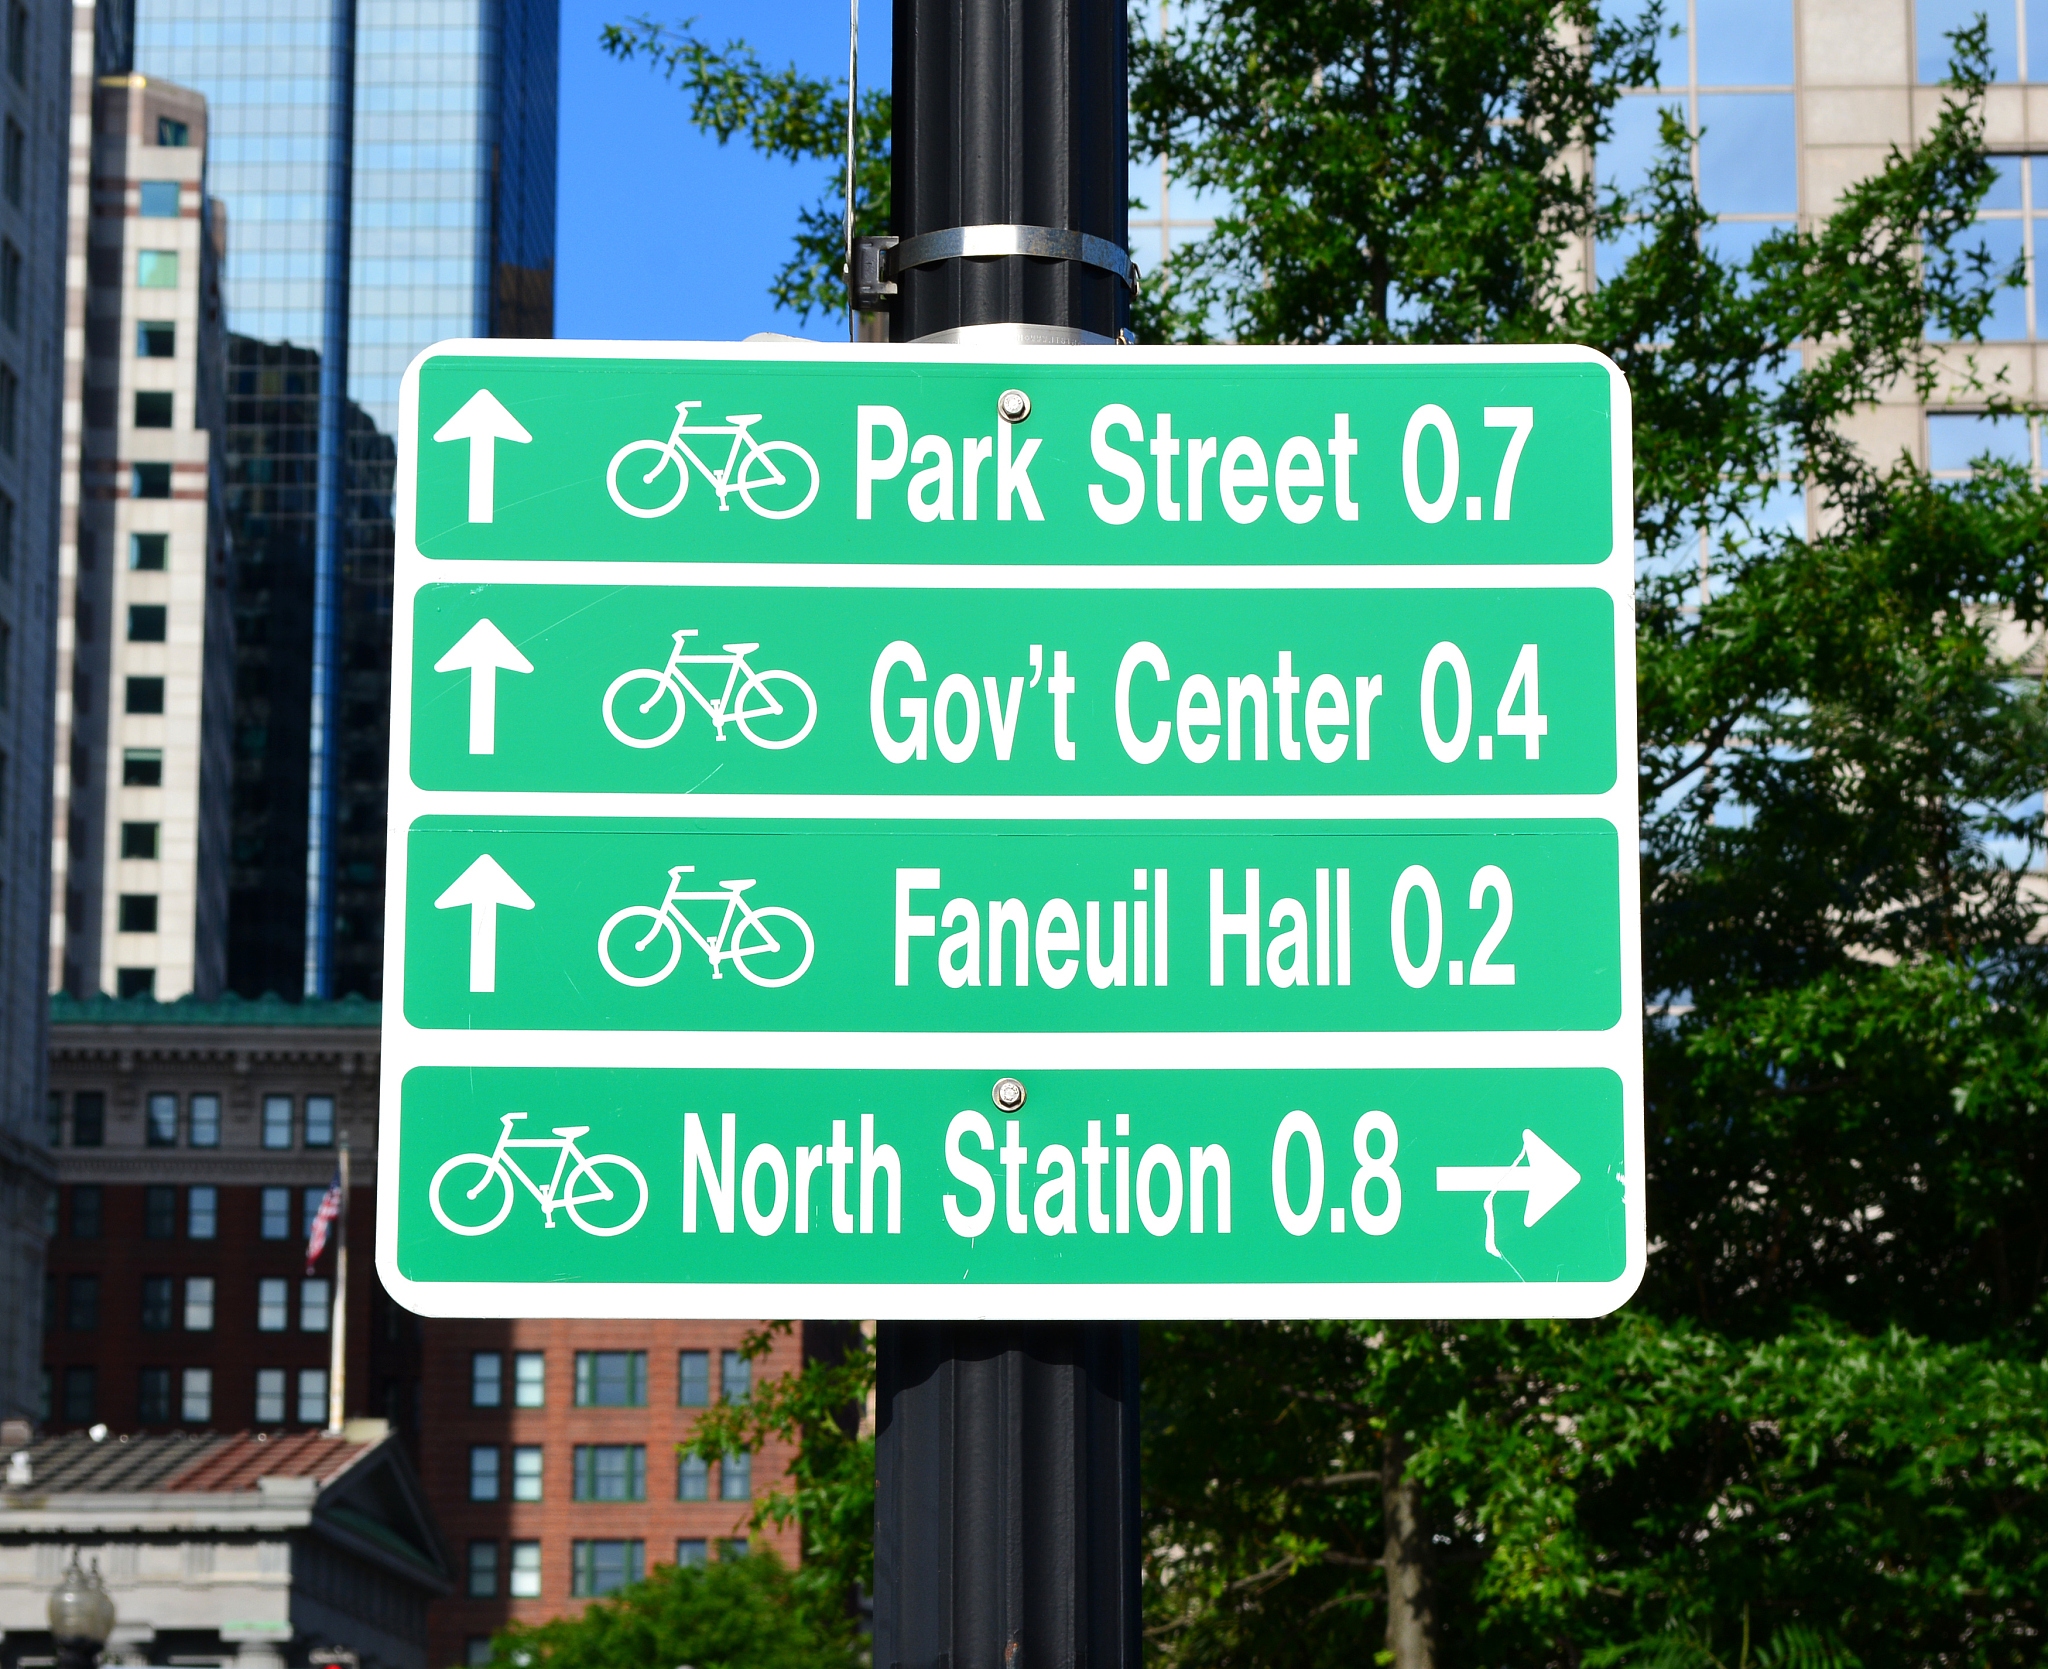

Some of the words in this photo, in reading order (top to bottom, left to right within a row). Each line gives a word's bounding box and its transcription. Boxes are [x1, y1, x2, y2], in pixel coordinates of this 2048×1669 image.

[857, 404, 1046, 521] Park
[1089, 403, 1359, 525] Street
[1402, 403, 1534, 524] 0.7
[870, 640, 1076, 764] Gov’t
[1115, 640, 1383, 764] Center
[1420, 640, 1548, 764] 0.4
[894, 867, 1168, 990] Faneuil
[1209, 868, 1351, 989] Hall
[1390, 864, 1516, 989] 0.2
[682, 1112, 902, 1238] North
[942, 1109, 1232, 1238] Station
[1271, 1110, 1402, 1237] 0.8
